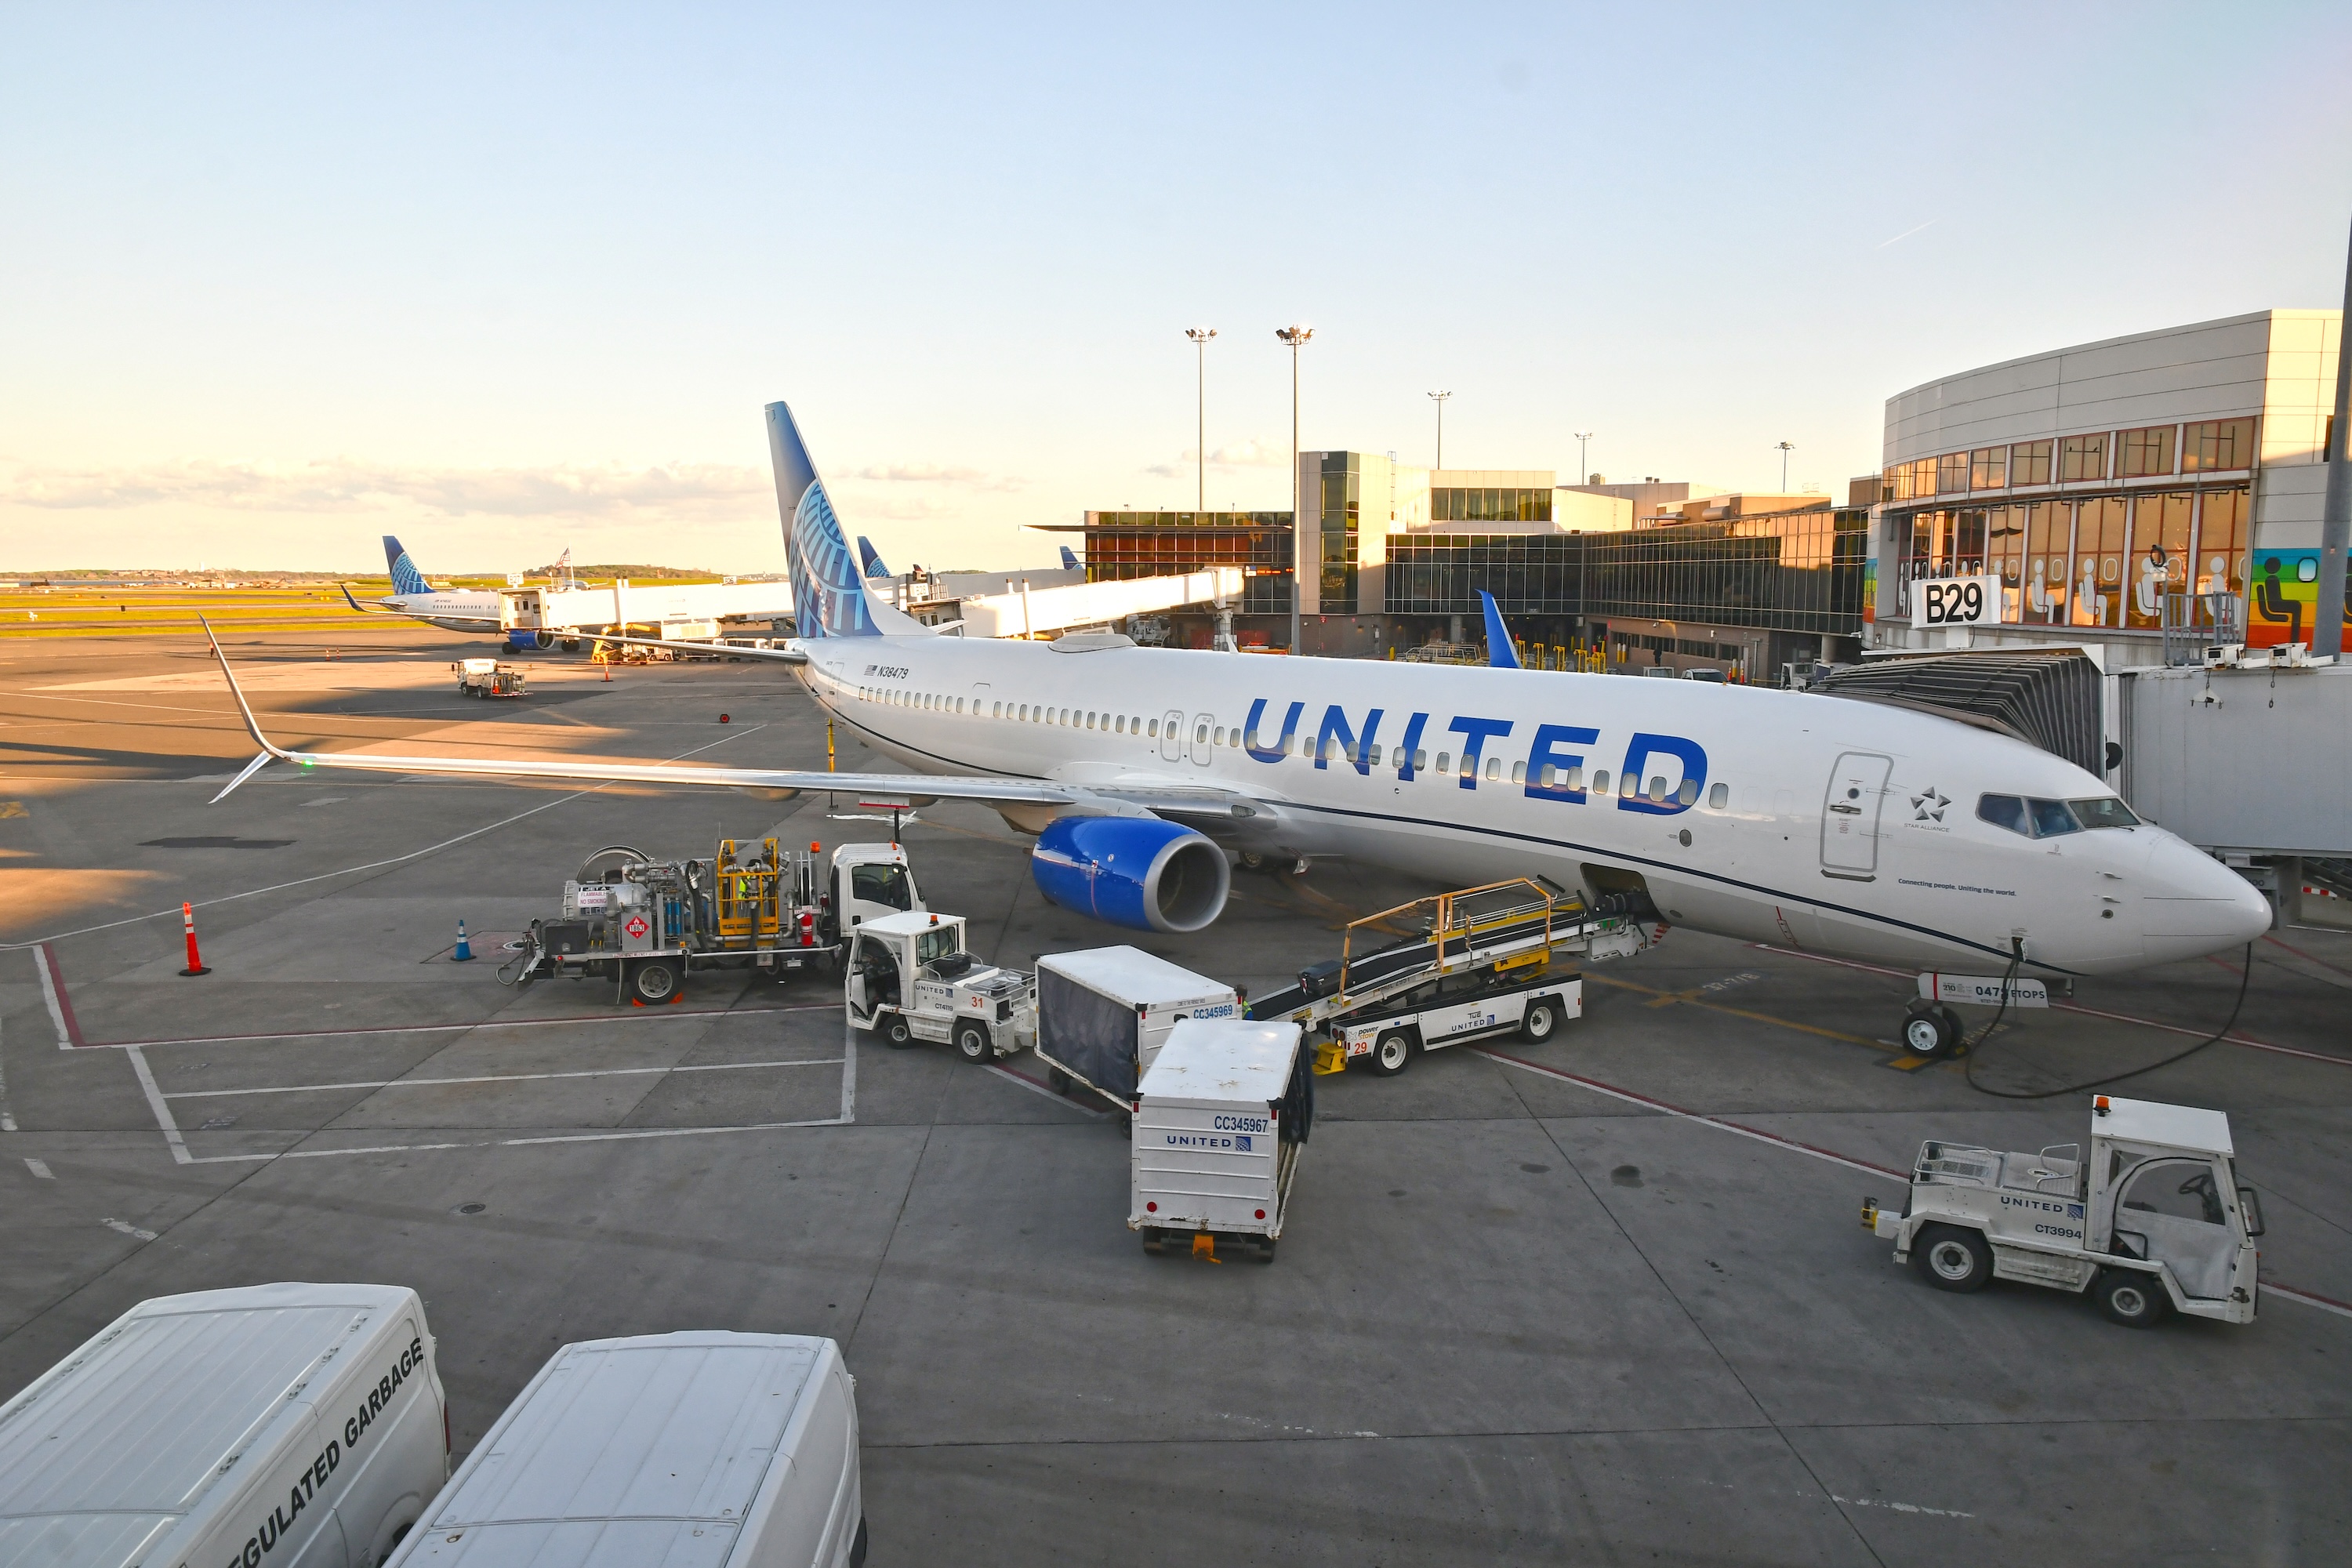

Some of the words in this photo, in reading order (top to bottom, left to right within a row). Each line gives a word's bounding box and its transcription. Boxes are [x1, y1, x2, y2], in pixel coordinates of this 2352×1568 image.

[1926, 583, 1982, 623] B29
[878, 666, 909, 679] N38479
[1243, 699, 1708, 815] UNITED
[1898, 878, 1933, 887] Connecting
[915, 985, 944, 994] UNITED
[1976, 986, 2007, 997] 047
[2011, 989, 2045, 1000] ETOPS
[935, 1003, 953, 1011] CT4119
[971, 996, 983, 1008] 31
[1193, 1004, 1232, 1019] CC345969
[1359, 1026, 1379, 1036] power
[1452, 1019, 1485, 1032] UNITED
[1355, 1042, 1367, 1054] 29
[1214, 1116, 1269, 1132] CC345967
[1167, 1135, 1231, 1147] UNITED
[2001, 1196, 2063, 1212] UNITED
[2035, 1225, 2082, 1239] CT3994
[345, 1338, 423, 1447] GARBAGE
